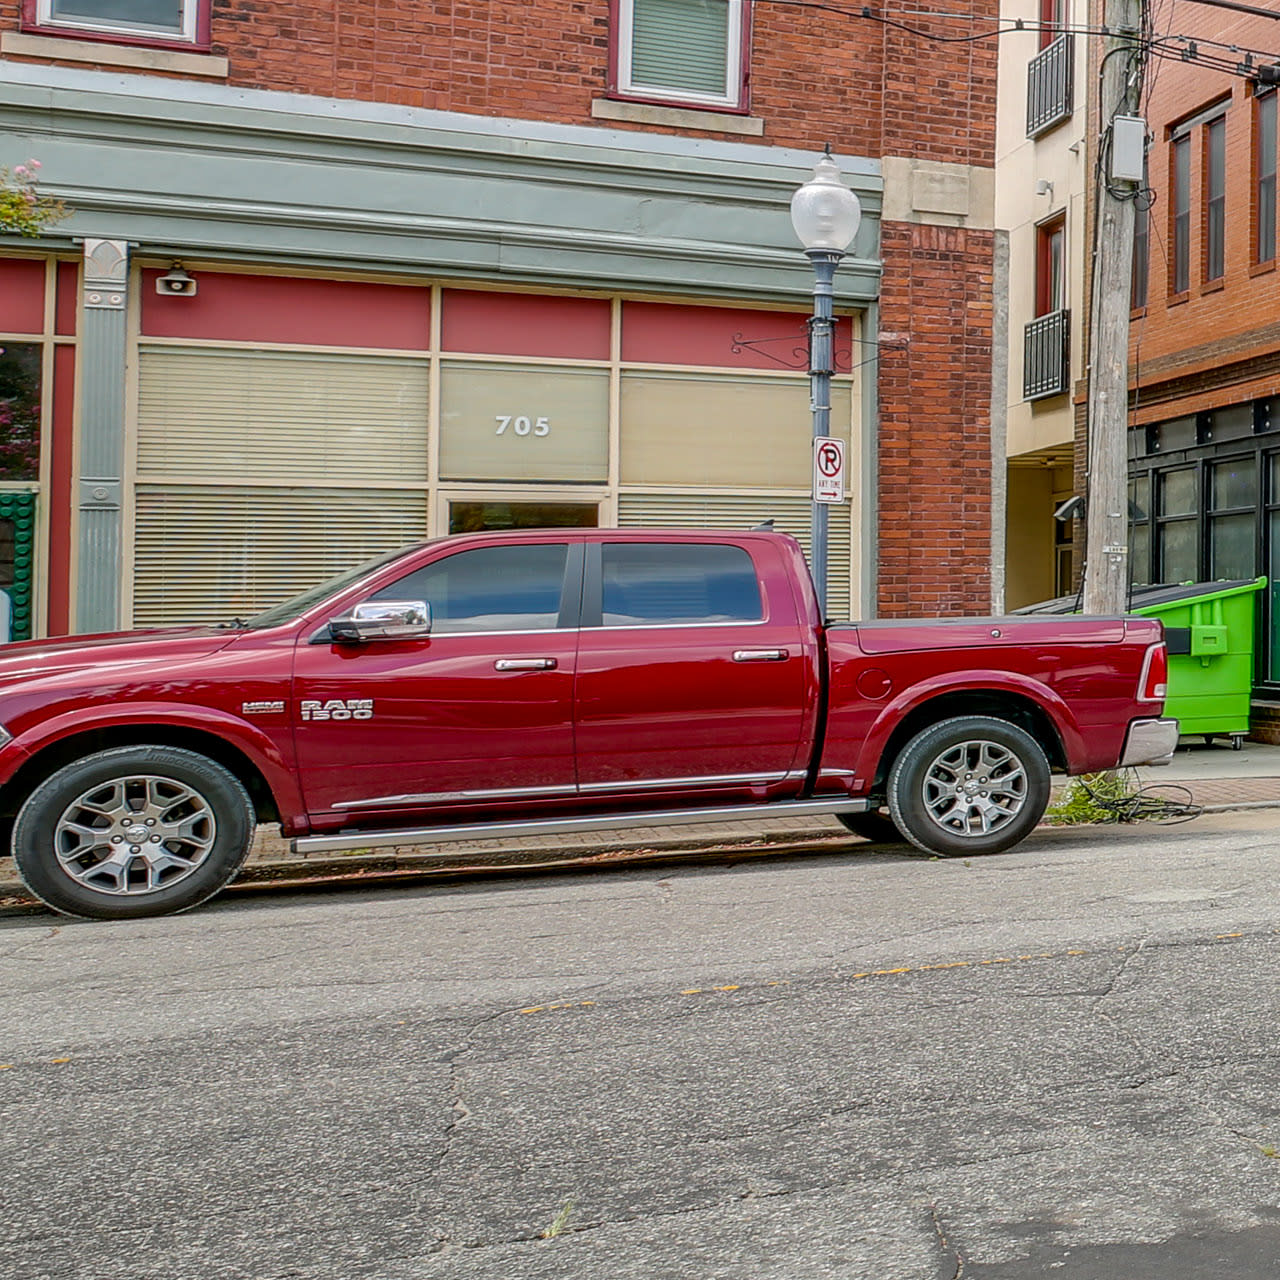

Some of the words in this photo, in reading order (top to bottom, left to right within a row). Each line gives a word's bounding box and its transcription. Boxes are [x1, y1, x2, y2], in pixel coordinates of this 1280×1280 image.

[495, 415, 550, 437] 705
[301, 699, 374, 710] RAM
[301, 709, 374, 721] 1500
